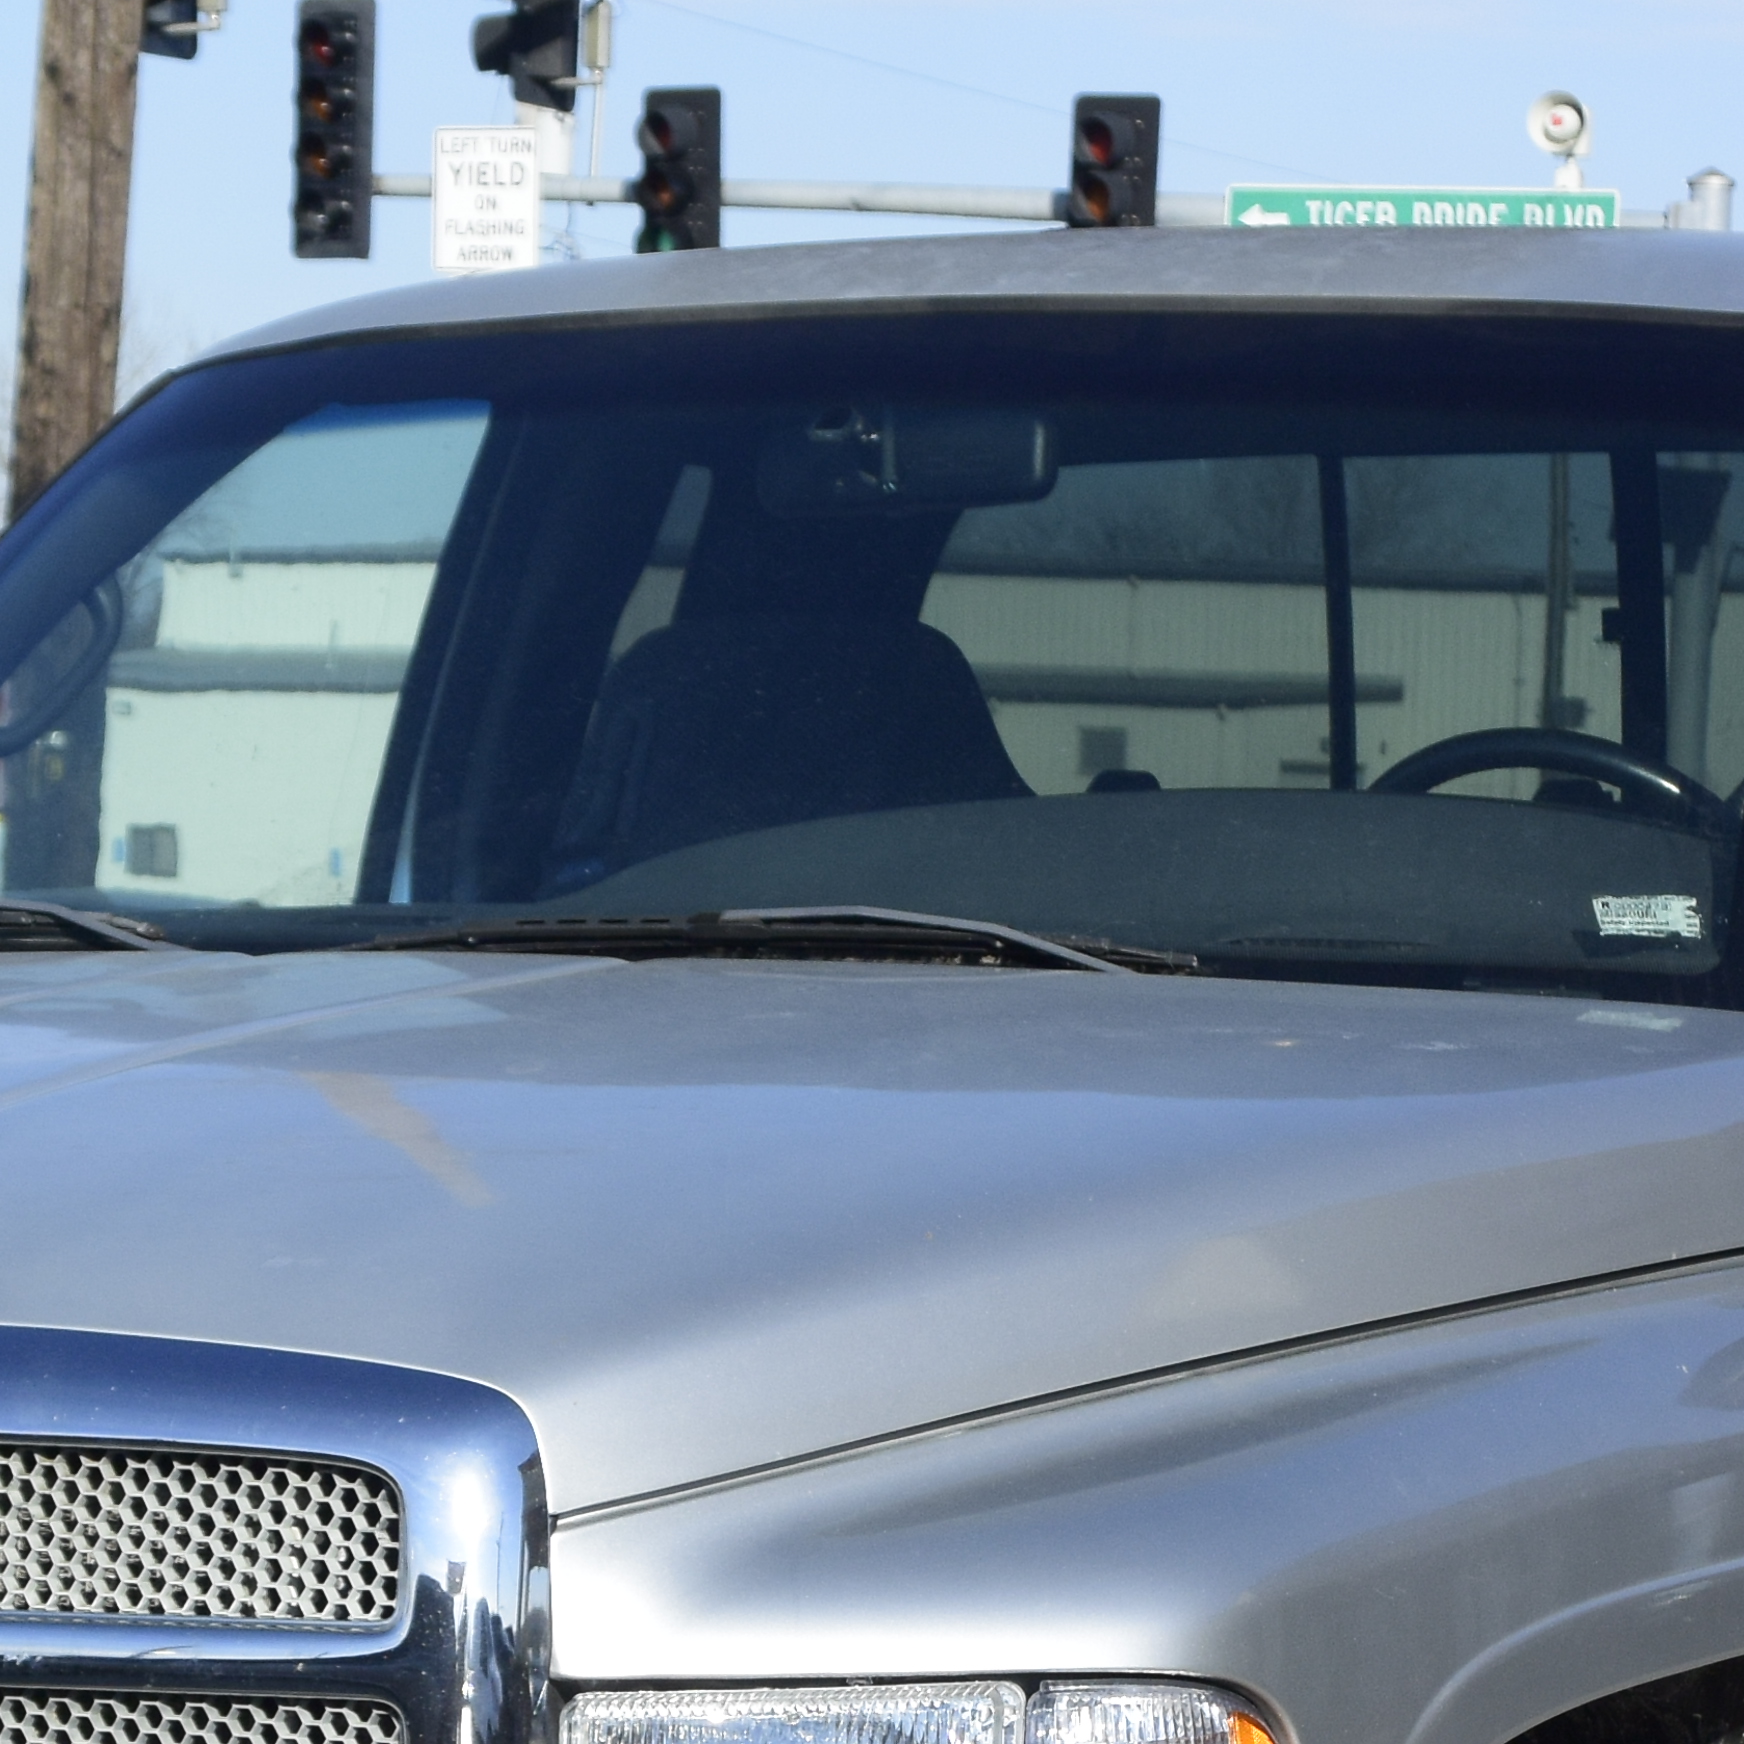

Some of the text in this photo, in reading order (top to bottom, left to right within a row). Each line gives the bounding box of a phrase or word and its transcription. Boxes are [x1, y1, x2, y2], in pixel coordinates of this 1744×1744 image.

[440, 136, 532, 153] LEFT TURN
[448, 161, 525, 187] YIELD
[474, 194, 497, 211] ON
[444, 218, 525, 236] FLASHING
[456, 244, 513, 262] ARROW
